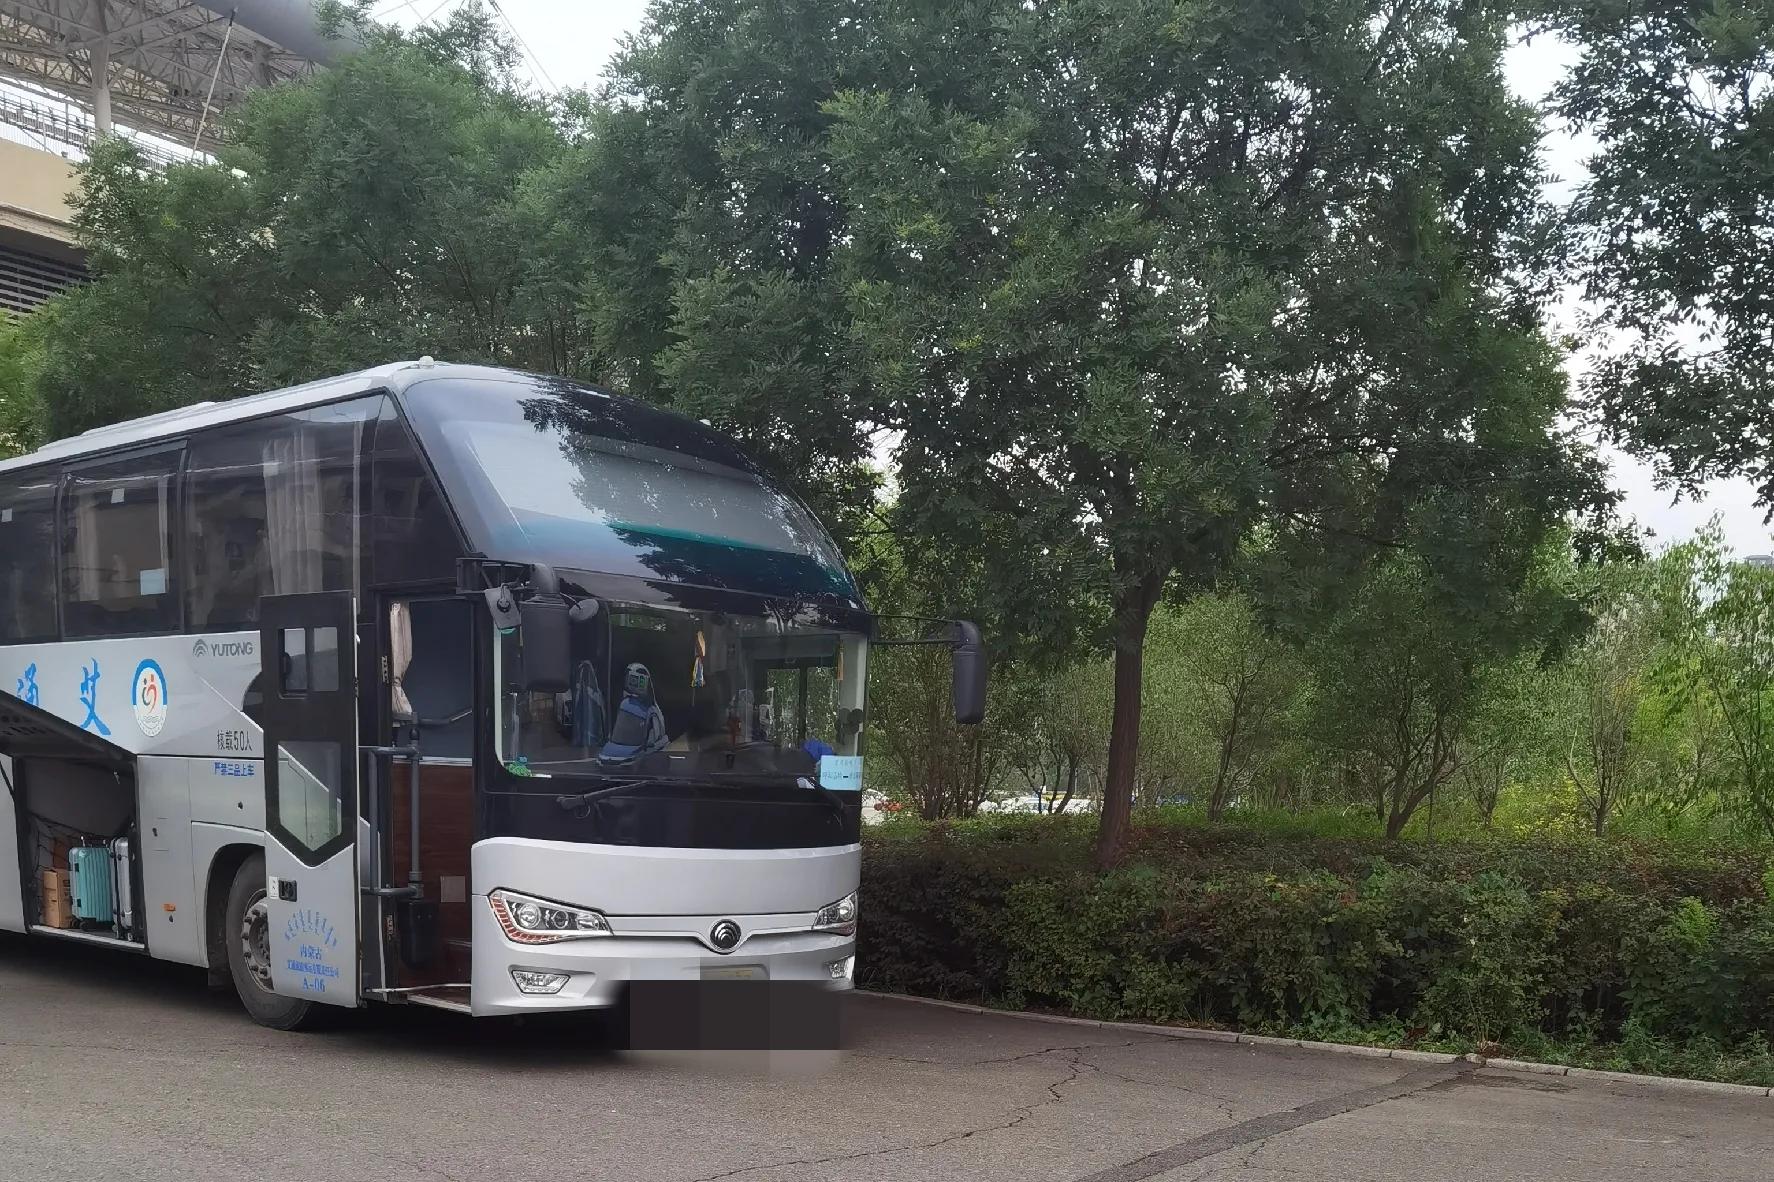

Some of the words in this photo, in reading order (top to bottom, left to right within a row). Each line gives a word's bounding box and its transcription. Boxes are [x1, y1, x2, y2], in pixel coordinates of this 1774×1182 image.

[211, 641, 253, 656] YUTONG
[216, 729, 253, 751] 核载50人
